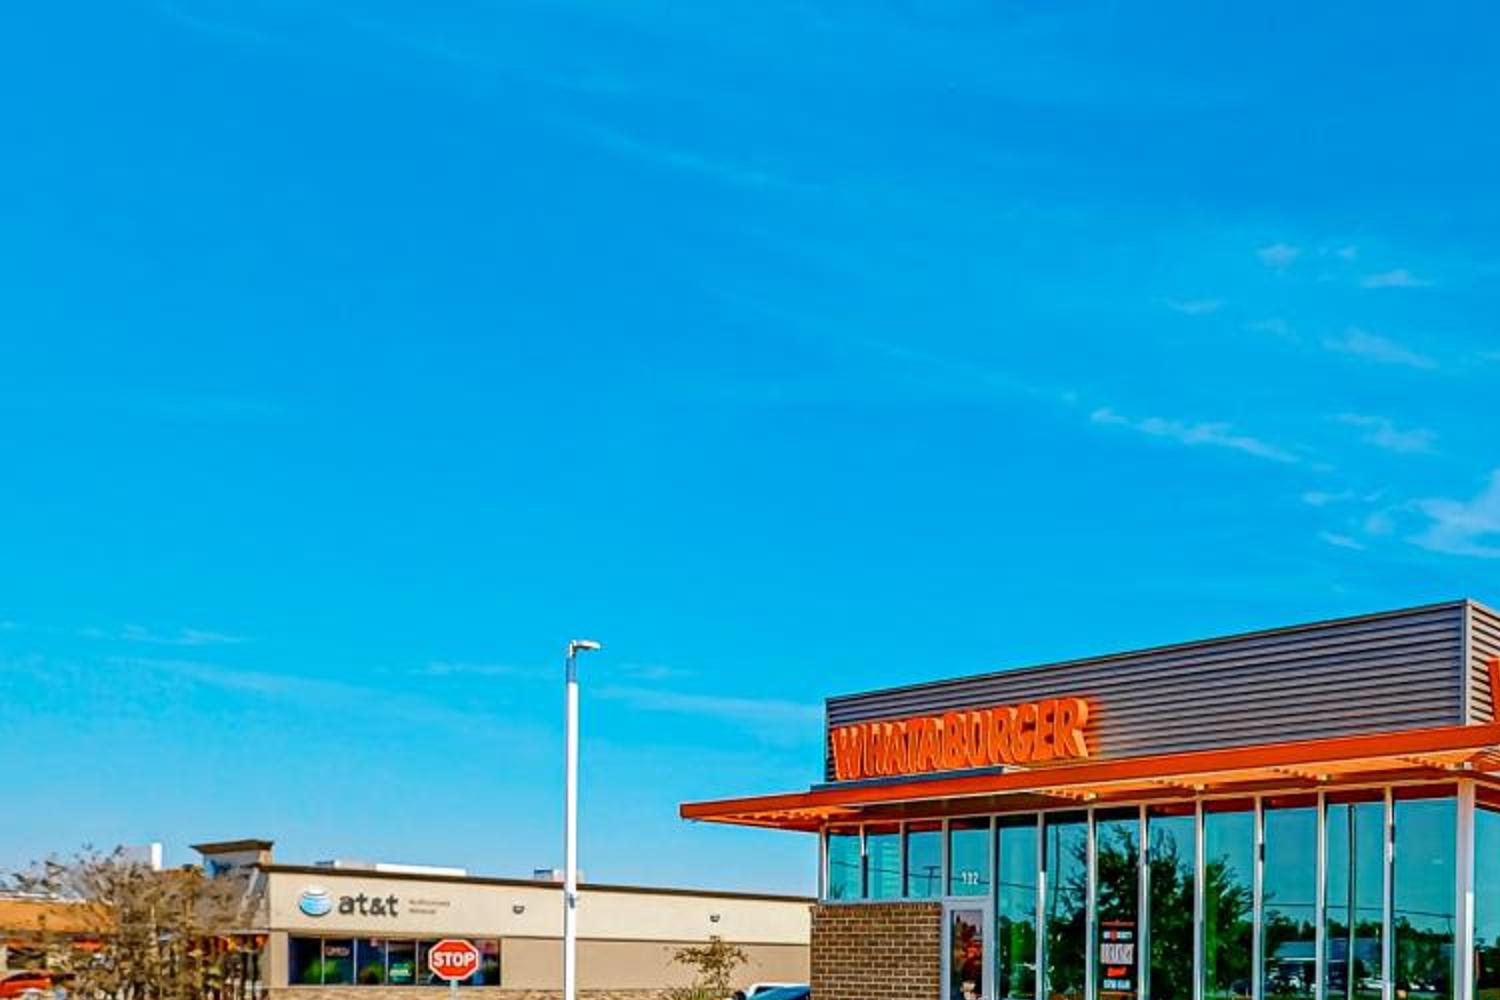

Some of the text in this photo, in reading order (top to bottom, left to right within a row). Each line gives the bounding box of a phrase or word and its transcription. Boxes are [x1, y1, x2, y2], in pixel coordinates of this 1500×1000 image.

[832, 698, 1089, 781] WHATABURGER
[338, 893, 399, 917] at&t
[433, 951, 475, 967] STOP
